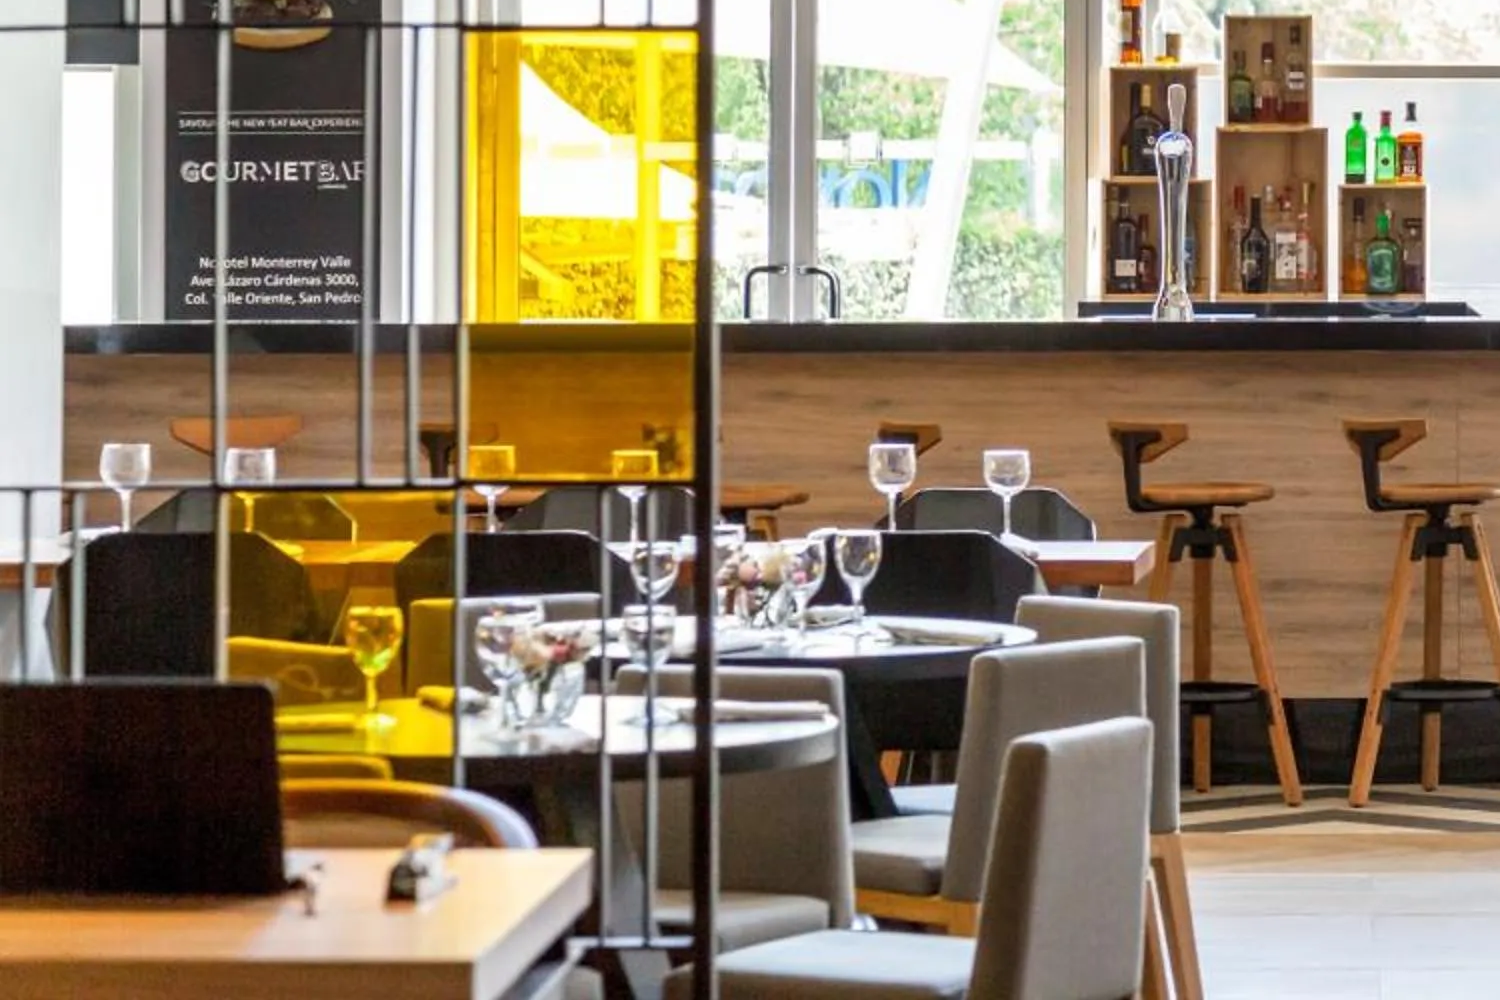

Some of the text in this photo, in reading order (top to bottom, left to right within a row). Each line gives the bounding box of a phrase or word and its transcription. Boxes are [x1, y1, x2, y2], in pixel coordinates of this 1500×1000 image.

[199, 255, 351, 270] Nootel Monterrey Valle
[263, 274, 321, 287] Cárdenas
[325, 273, 359, 287] 3000,
[185, 292, 209, 305] Col.
[245, 291, 296, 306] Oriente,
[299, 291, 322, 305] San
[325, 291, 362, 305] Pedro
